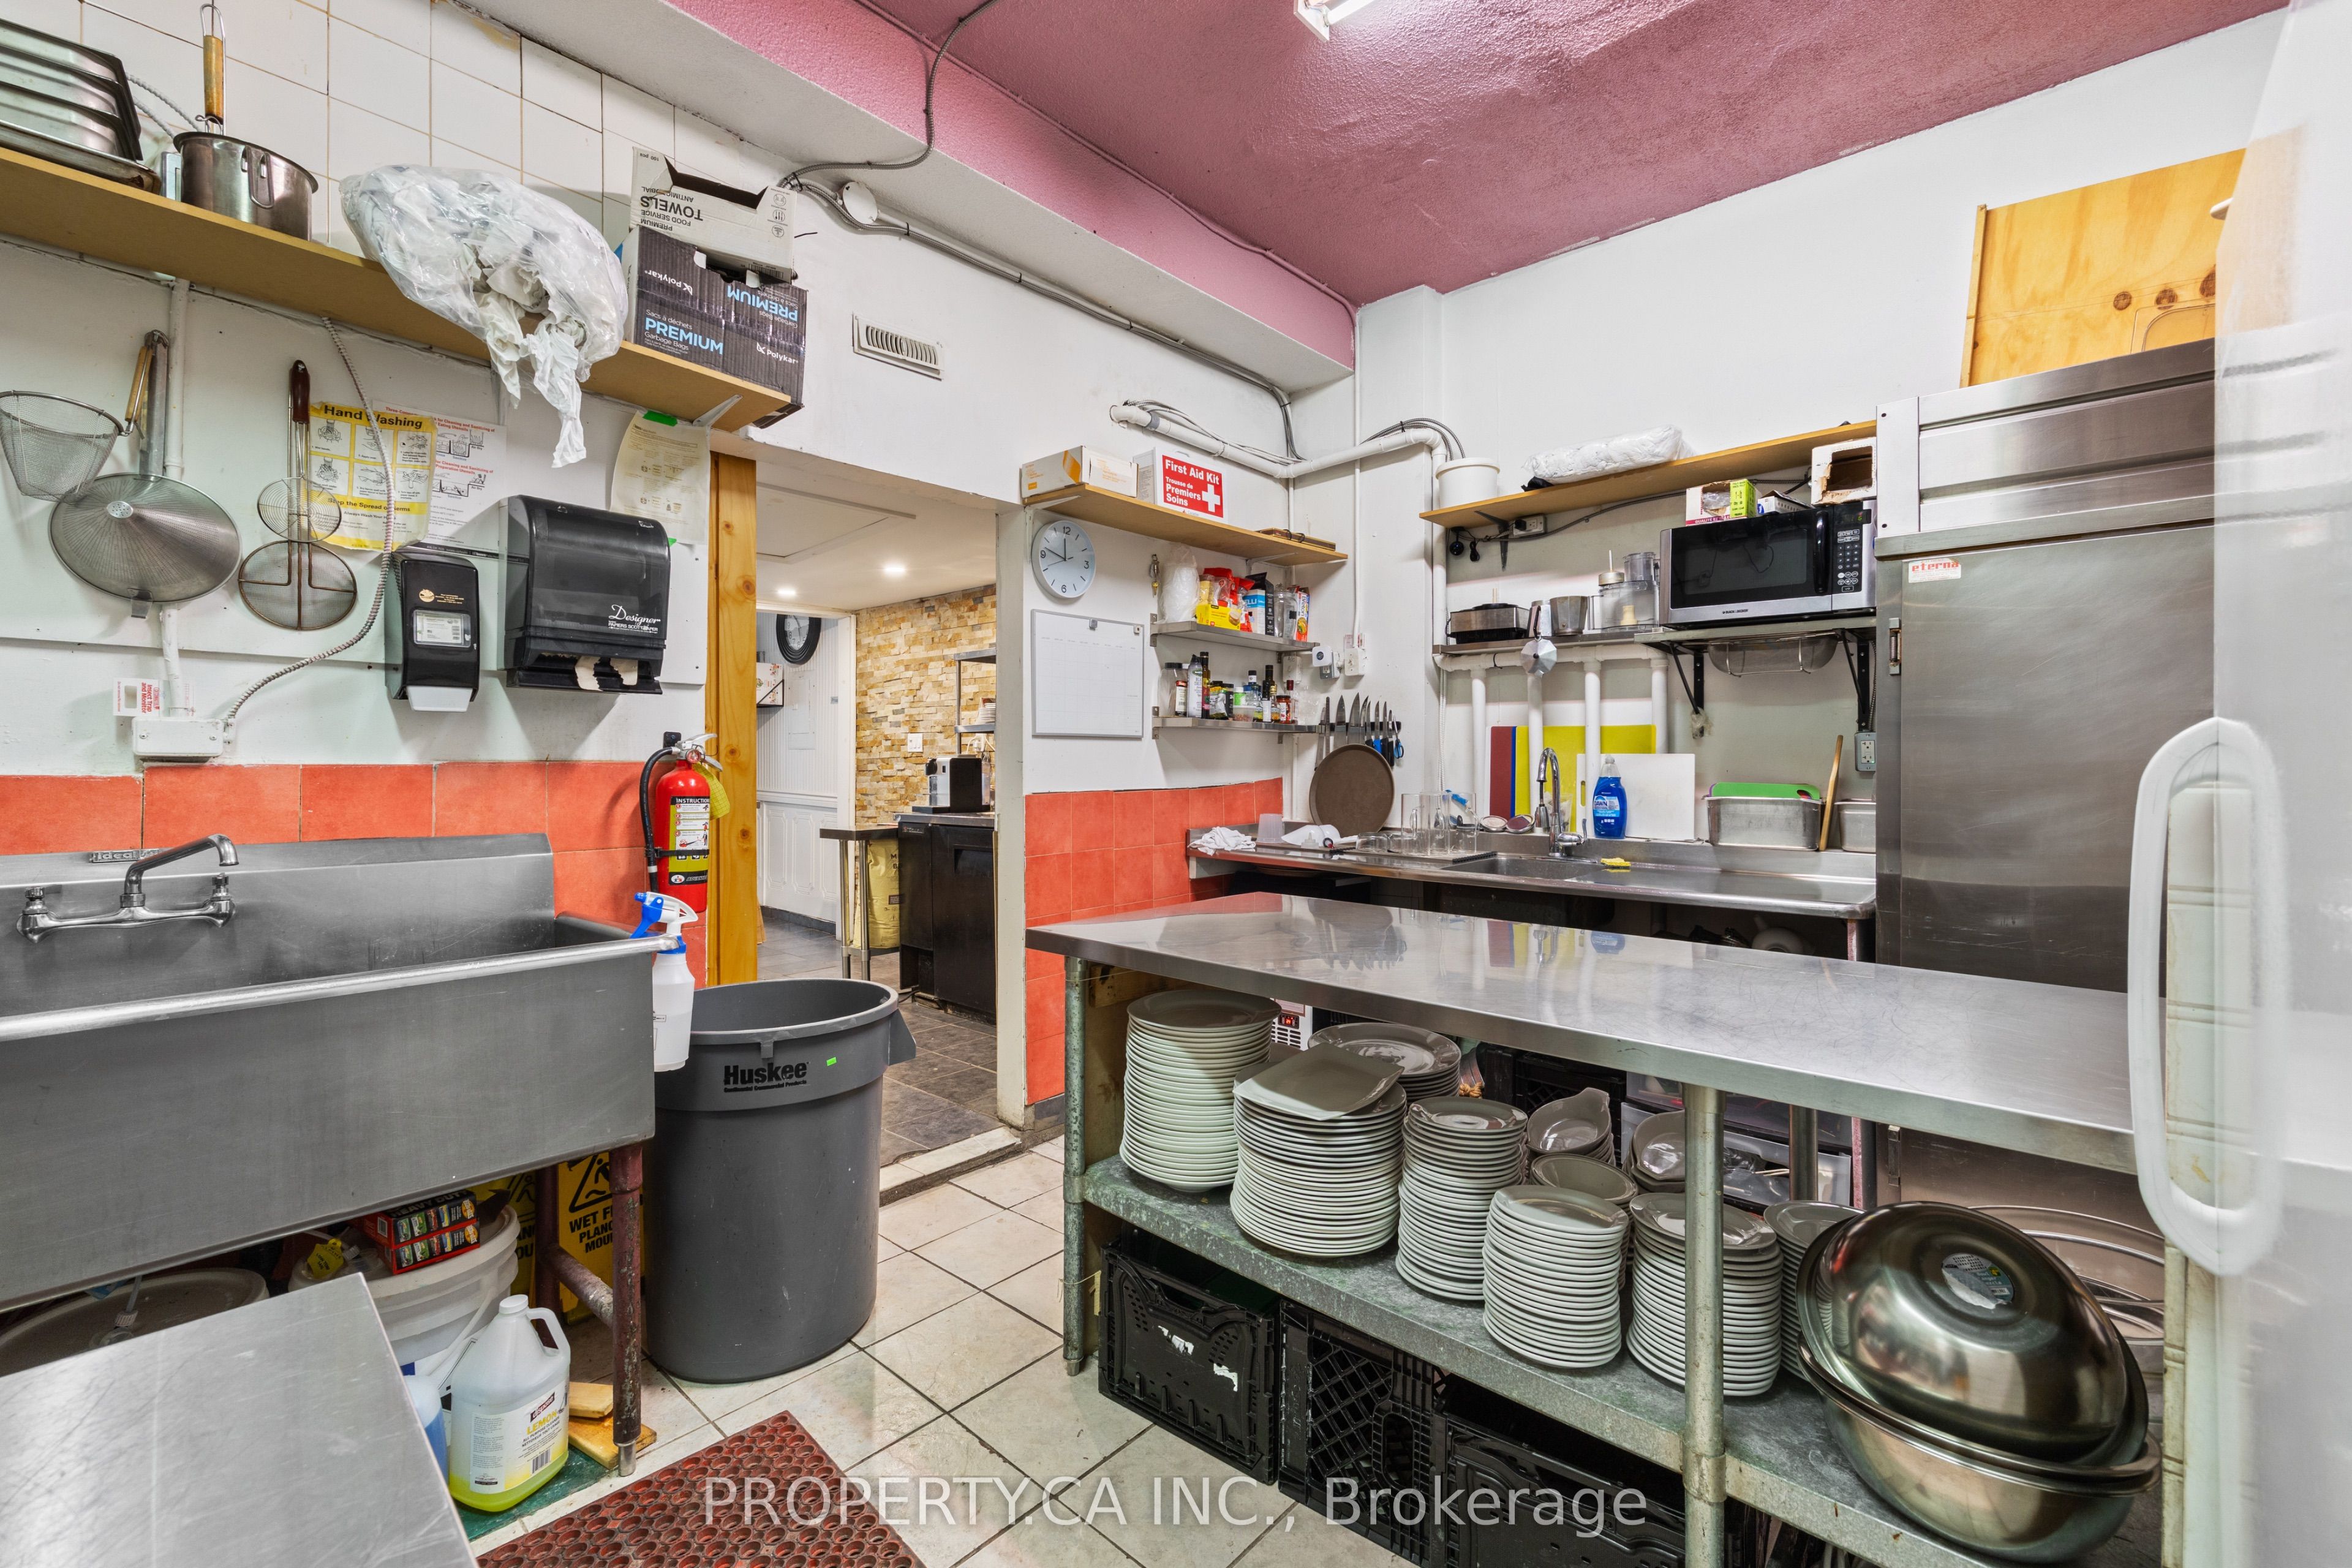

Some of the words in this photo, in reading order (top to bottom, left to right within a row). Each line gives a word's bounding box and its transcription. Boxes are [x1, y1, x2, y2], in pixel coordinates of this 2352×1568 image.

[640, 195, 703, 221] TOWELS
[641, 209, 670, 221] SERVICE
[641, 219, 673, 231] PREMIUM
[671, 217, 691, 227] FOOD
[647, 270, 682, 287] Polykar
[727, 285, 798, 322] PREMIUM
[646, 309, 661, 320] Sacs
[668, 317, 693, 330] déchets
[644, 331, 672, 345] Garbage
[674, 341, 689, 351] Bags
[645, 317, 723, 355] PREMIUM
[767, 349, 796, 364] Polykar
[324, 405, 362, 420] Hand
[1165, 459, 1188, 475] First
[1189, 467, 1204, 480] Aid
[1206, 472, 1219, 485] Kit
[1165, 477, 1186, 487] Trousse
[1166, 483, 1201, 501] Premiers
[1166, 493, 1188, 507] Soins
[1063, 526, 1071, 535] 12
[1040, 550, 1046, 559] 9
[1084, 560, 1090, 569] 3
[1912, 561, 1959, 571] eterna
[1061, 584, 1067, 593] 6
[608, 604, 662, 626] Designer
[723, 1062, 807, 1085] Huskee
[569, 1210, 598, 1233] WET
[527, 1411, 557, 1434] LEMON
[530, 1427, 546, 1439] PURPOSE
[546, 1416, 560, 1428] CLEANER
[522, 1434, 541, 1447] NETTOYEUR
